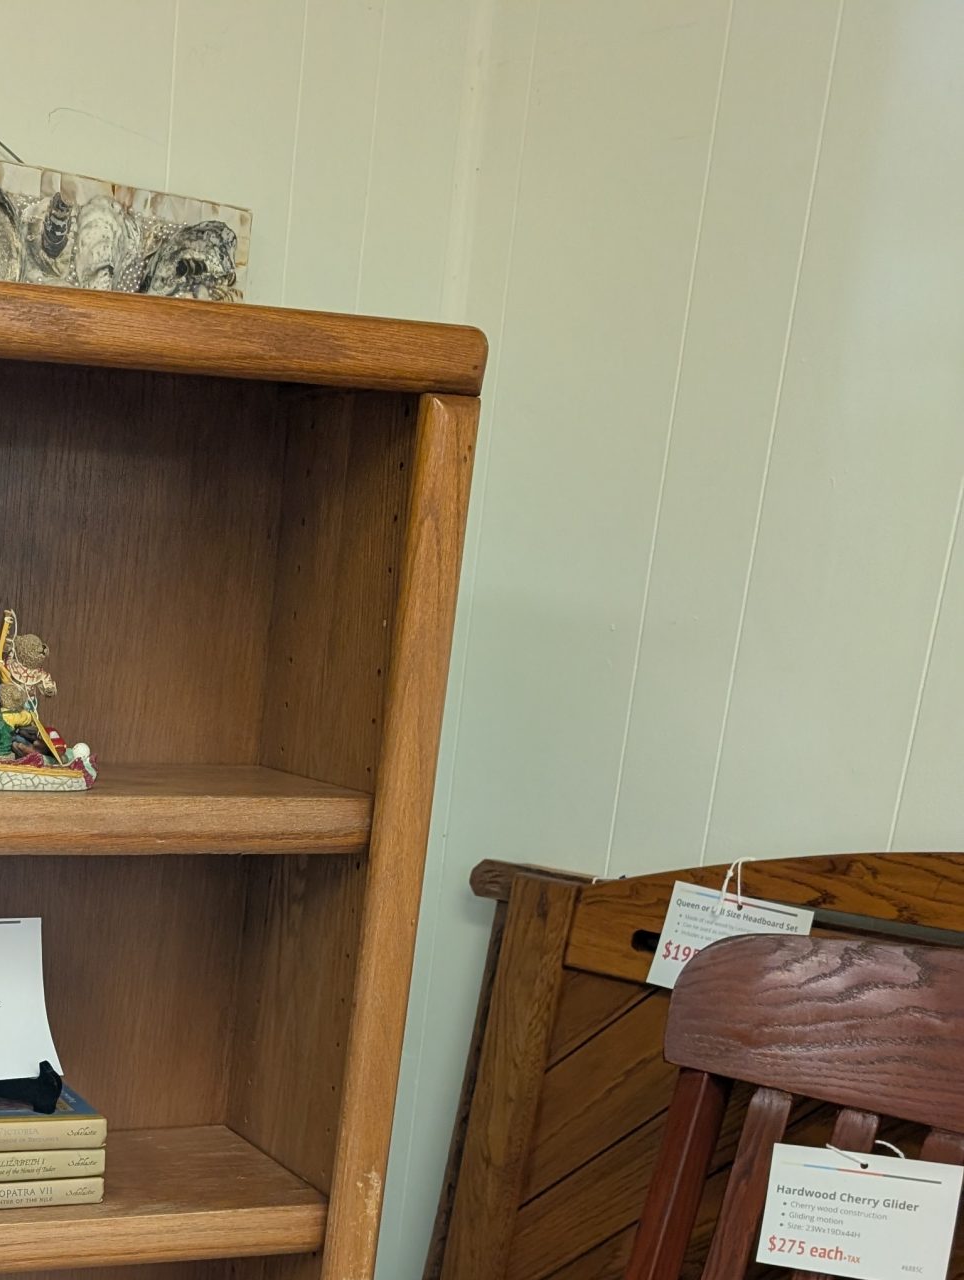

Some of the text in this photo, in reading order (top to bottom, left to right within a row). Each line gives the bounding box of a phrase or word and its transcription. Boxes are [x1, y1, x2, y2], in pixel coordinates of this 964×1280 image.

[676, 898, 700, 910] Queen
[711, 906, 725, 916] ll
[726, 910, 742, 920] Size
[742, 912, 785, 929] Headboard
[786, 922, 798, 932] Set
[66, 1126, 97, 1136] Scholastic
[67, 1156, 98, 1167] Scholastic
[6, 1168, 12, 1176] of
[36, 1166, 42, 1174] of
[39, 1186, 53, 1194] VII
[66, 1187, 96, 1196] Scholastic
[776, 1184, 920, 1212] Hardwood Cherry Glider
[790, 1200, 888, 1220] Cherry wood construction
[788, 1211, 844, 1226] Gliding motion
[787, 1222, 804, 1231] Size:
[767, 1234, 806, 1256] $275
